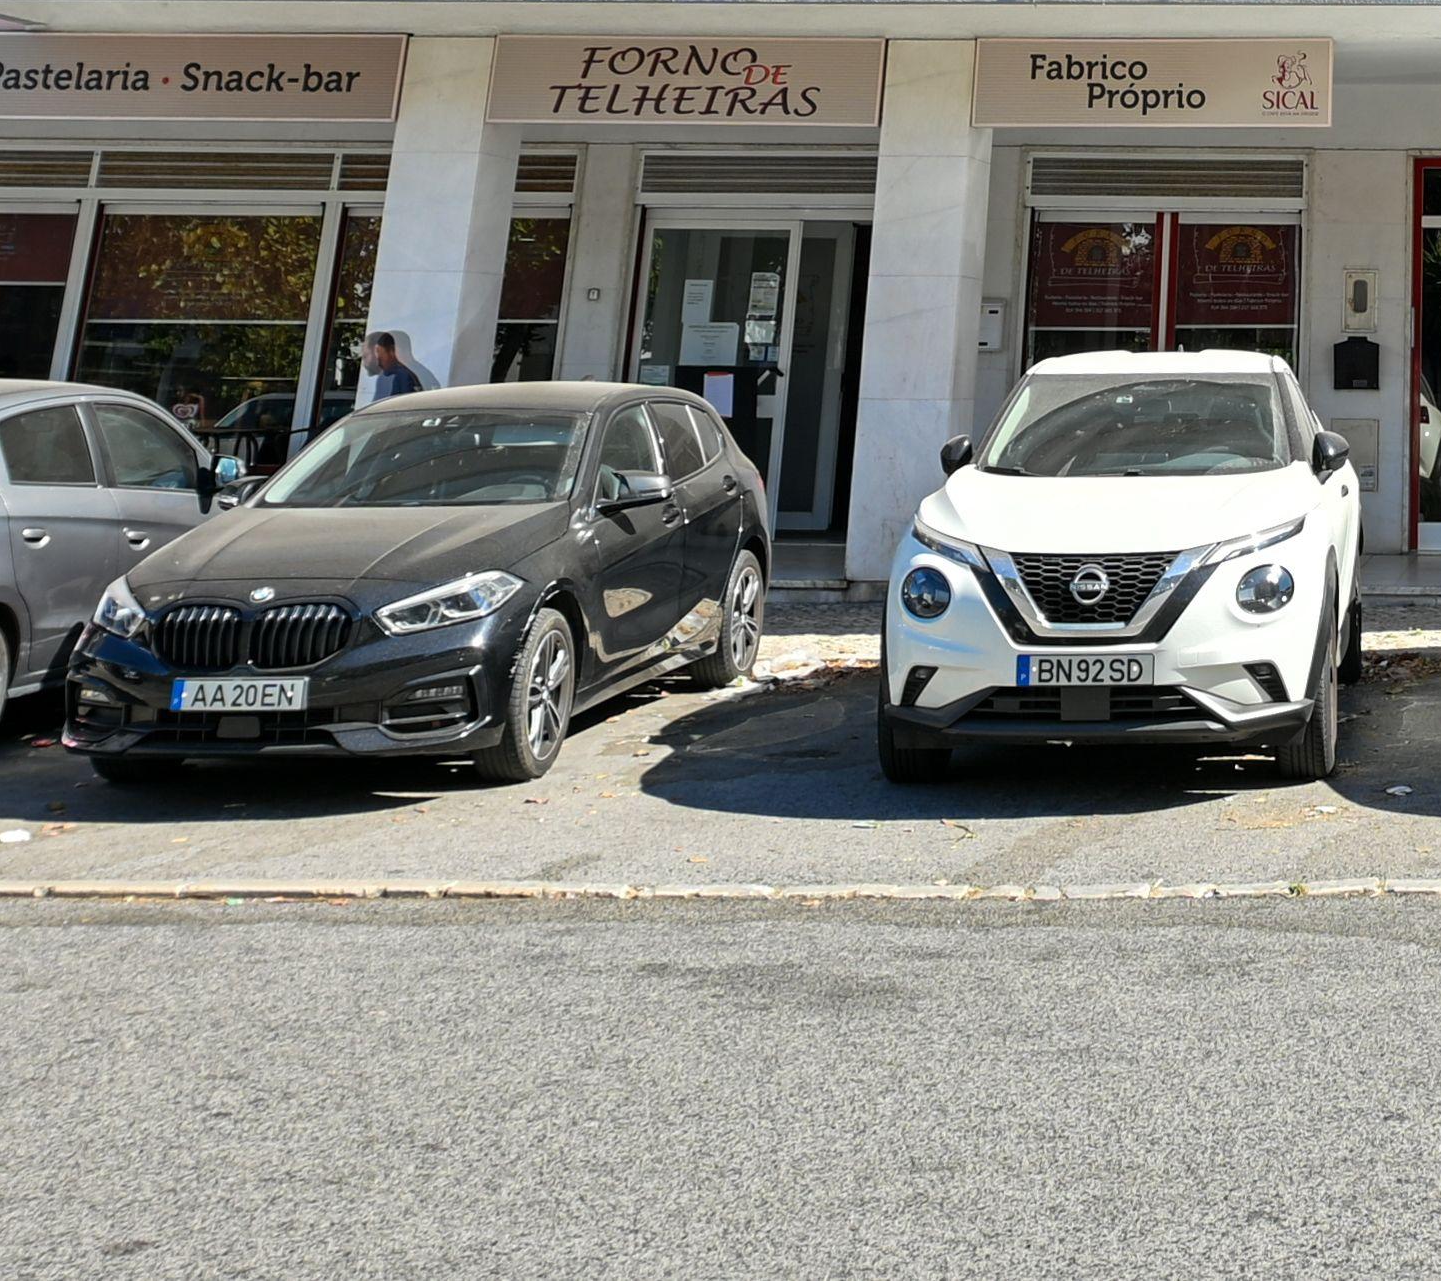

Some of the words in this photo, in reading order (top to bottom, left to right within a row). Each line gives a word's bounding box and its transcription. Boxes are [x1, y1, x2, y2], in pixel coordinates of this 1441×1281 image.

[180, 62, 361, 93] Snack-bar
[580, 45, 757, 79] FORNO
[743, 64, 792, 85] DE
[1030, 54, 1148, 80] Fabrico
[549, 83, 821, 116] TELHEIRAS
[1087, 82, 1206, 115] Próprio
[1262, 91, 1319, 110] SICAL
[1070, 582, 1108, 590] NISSAN
